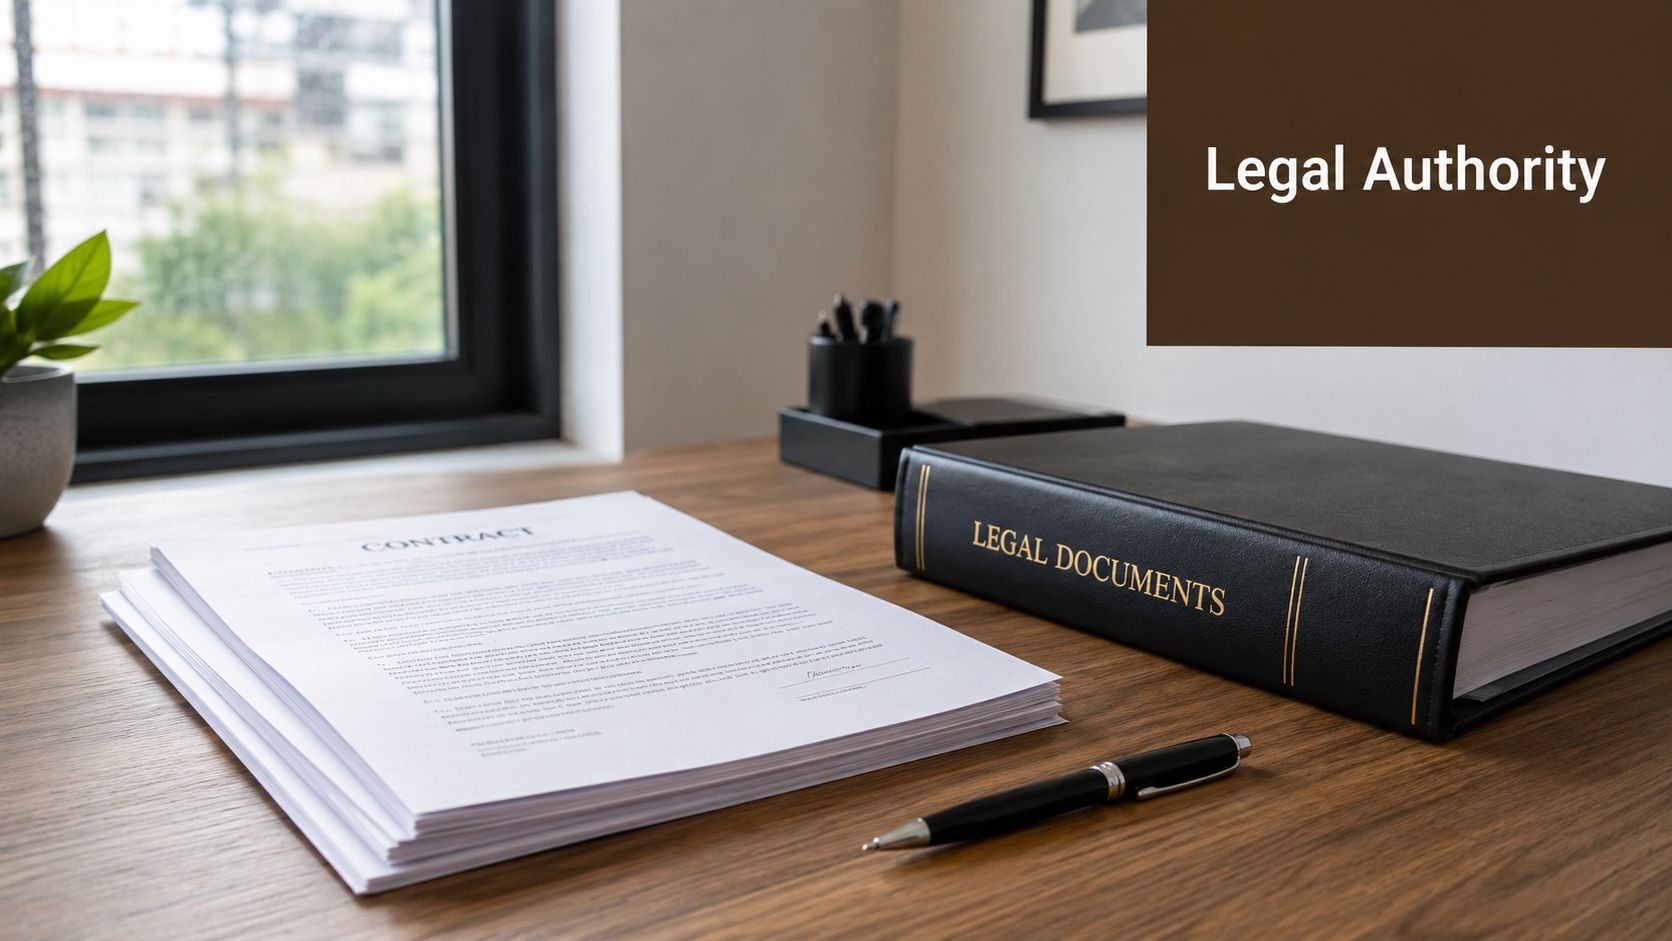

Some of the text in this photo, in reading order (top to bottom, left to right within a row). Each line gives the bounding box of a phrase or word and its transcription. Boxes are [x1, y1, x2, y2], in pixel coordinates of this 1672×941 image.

[361, 526, 534, 552] CONTRACT
[972, 520, 1226, 616] LEGAL DOCUMENTS
